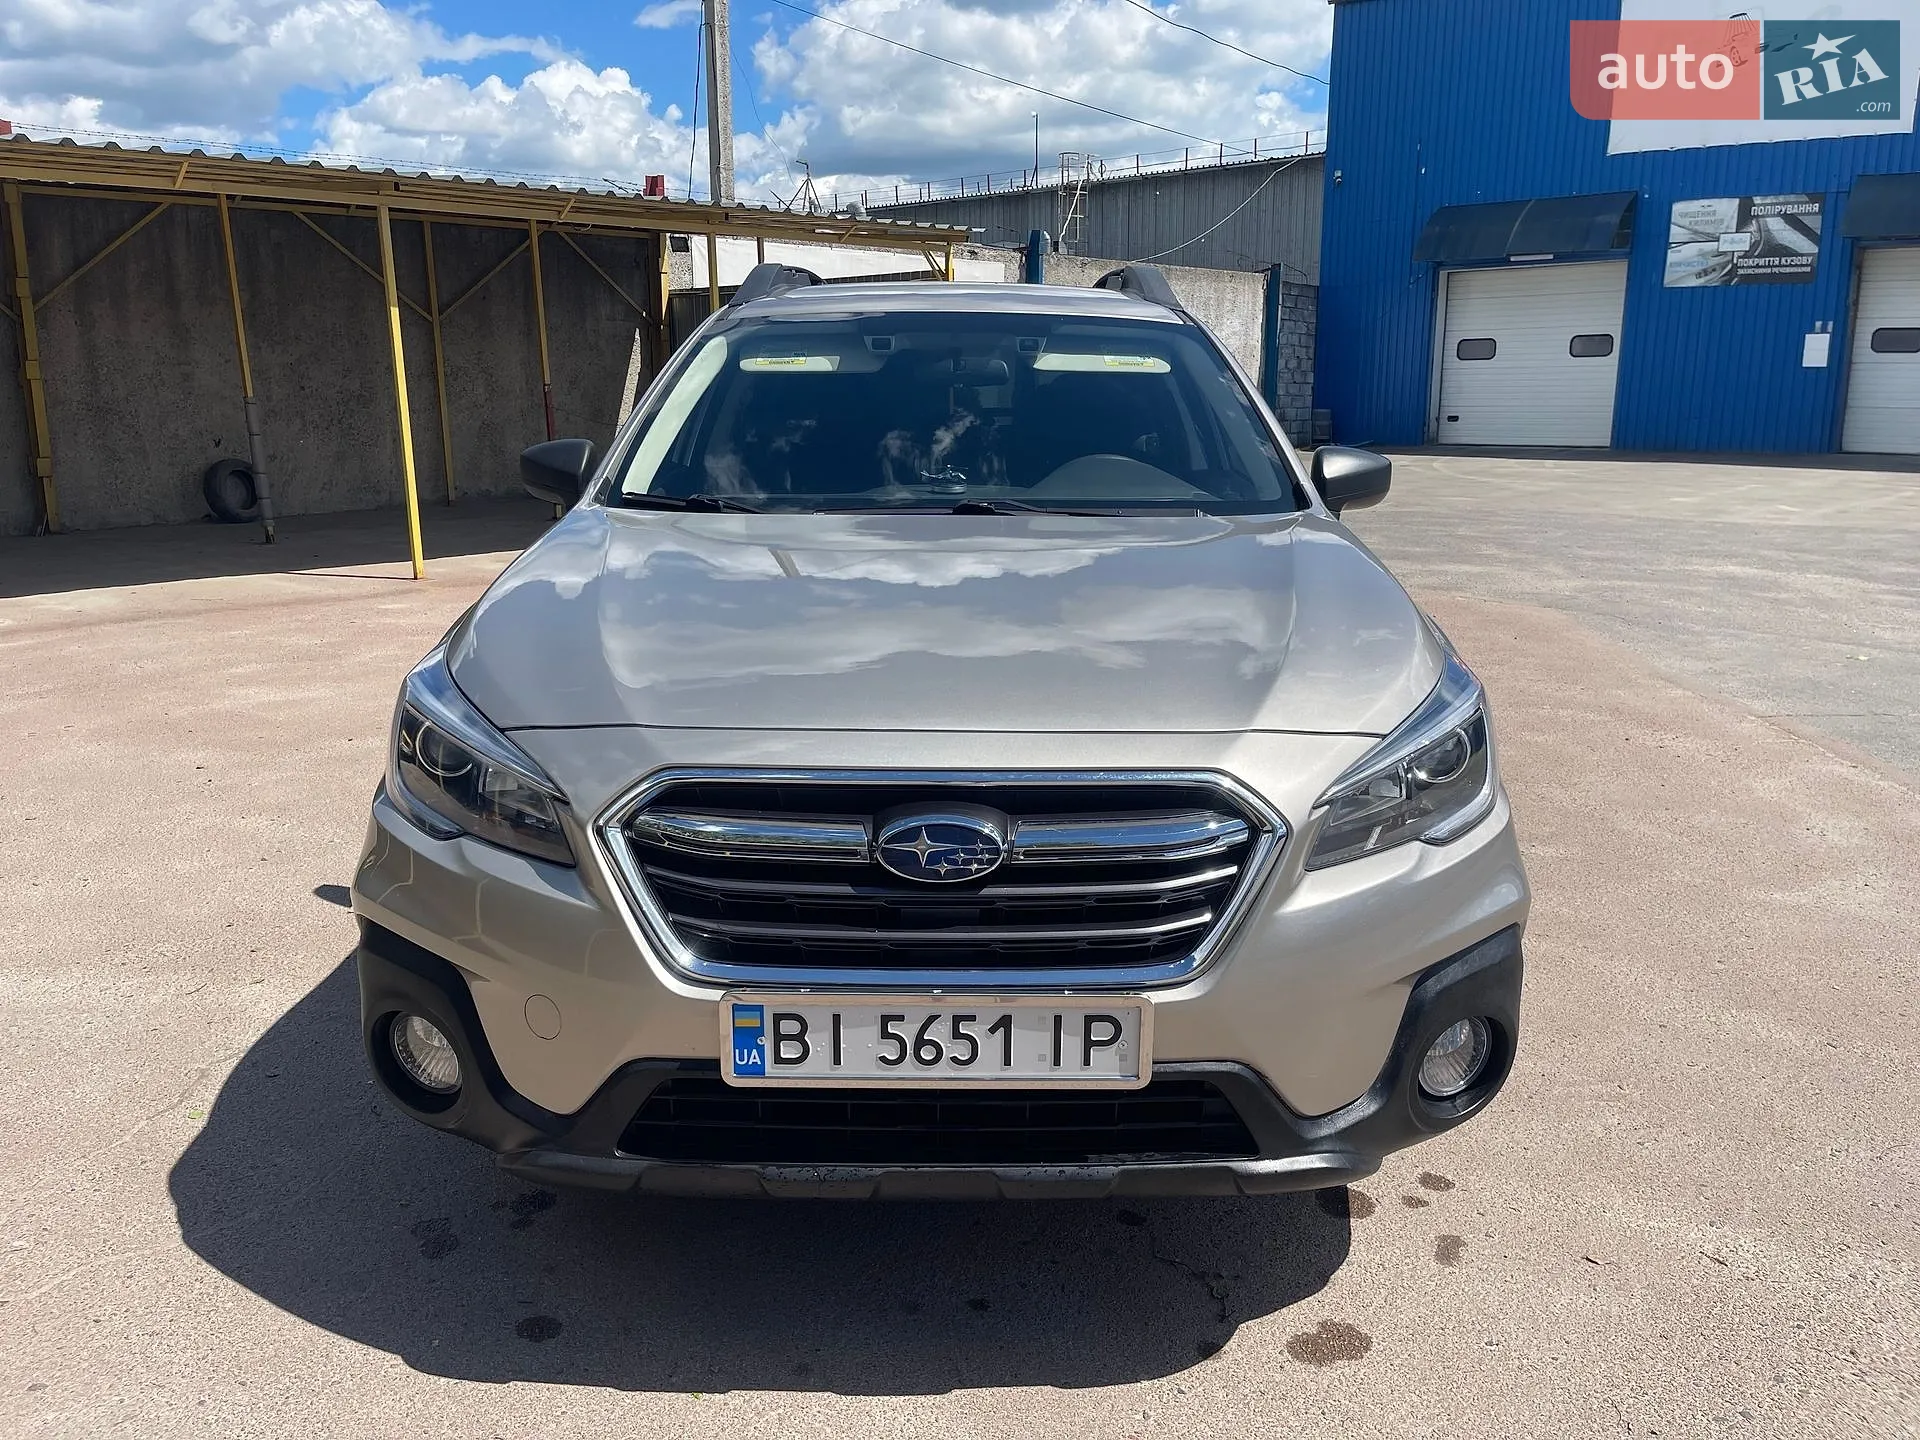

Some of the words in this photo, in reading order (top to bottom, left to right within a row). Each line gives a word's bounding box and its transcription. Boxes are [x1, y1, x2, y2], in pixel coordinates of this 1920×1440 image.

[1751, 203, 1819, 216] ПОЛІРУВАННЯ
[1737, 257, 1780, 267] ПОКРИТТЯ
[1781, 256, 1813, 265] КУЗОВУ
[772, 1013, 843, 1066] BI
[877, 1013, 1013, 1067] 5651
[1053, 1013, 1123, 1067] IP
[735, 1049, 762, 1065] UA
